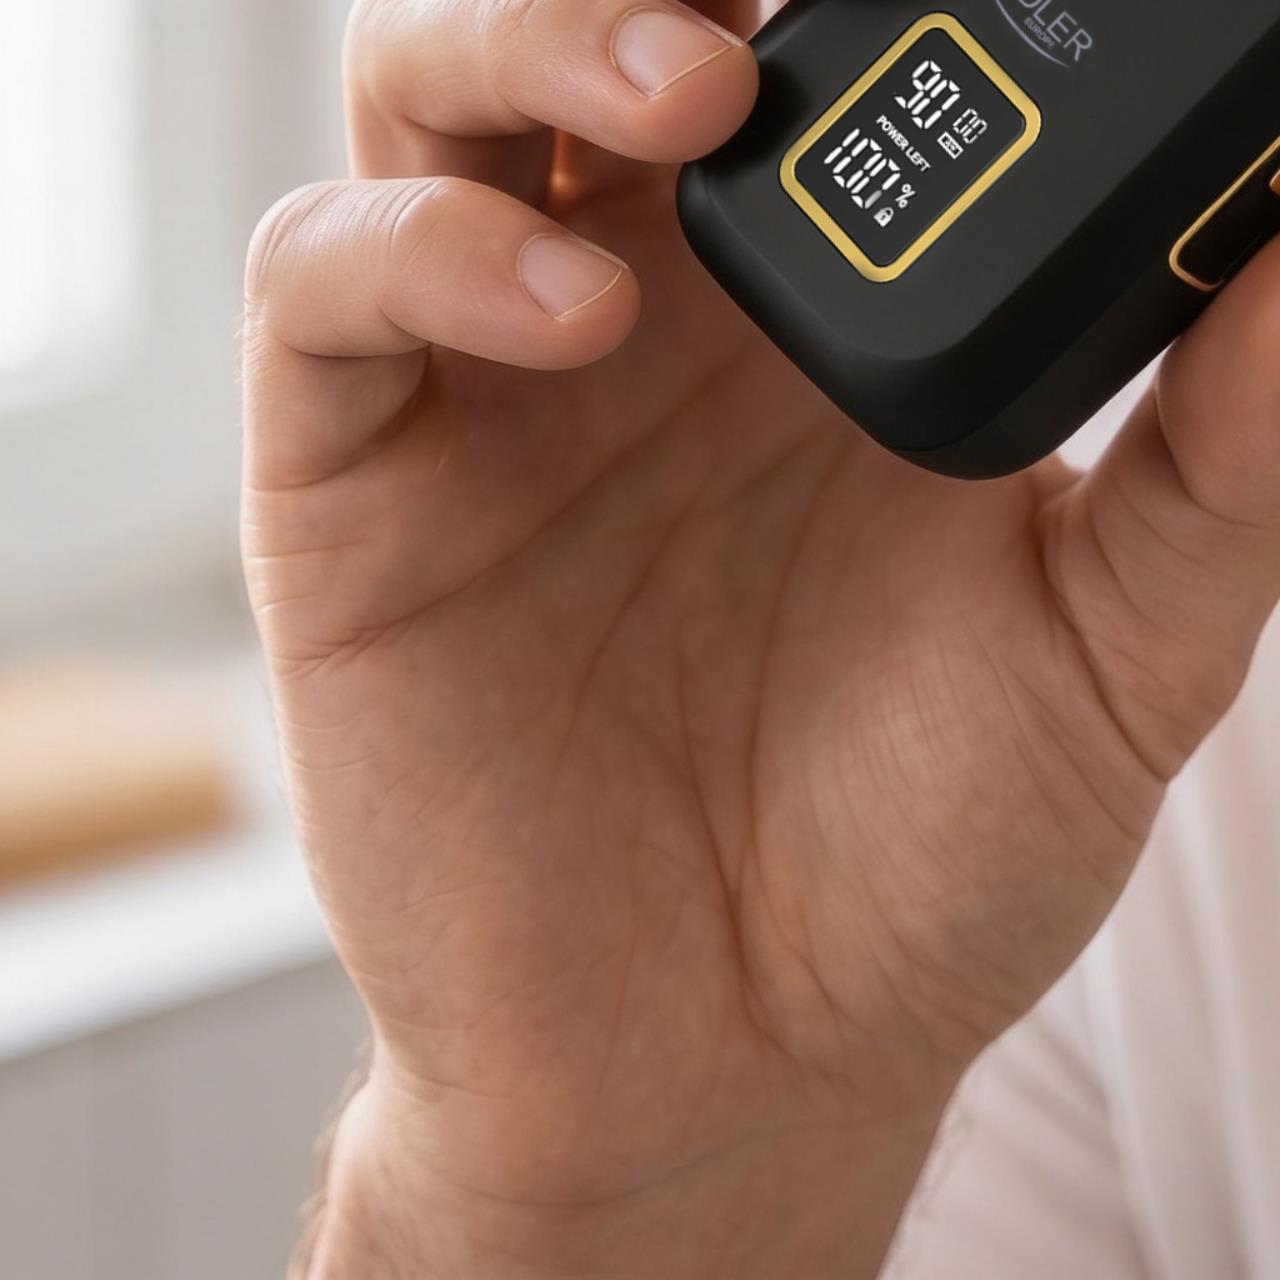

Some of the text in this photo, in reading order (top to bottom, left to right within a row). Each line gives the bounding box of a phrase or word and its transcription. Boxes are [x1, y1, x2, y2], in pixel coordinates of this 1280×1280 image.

[876, 114, 931, 172] POWER LEFT
[894, 60, 988, 145] 90 00
[824, 128, 901, 209] 100
